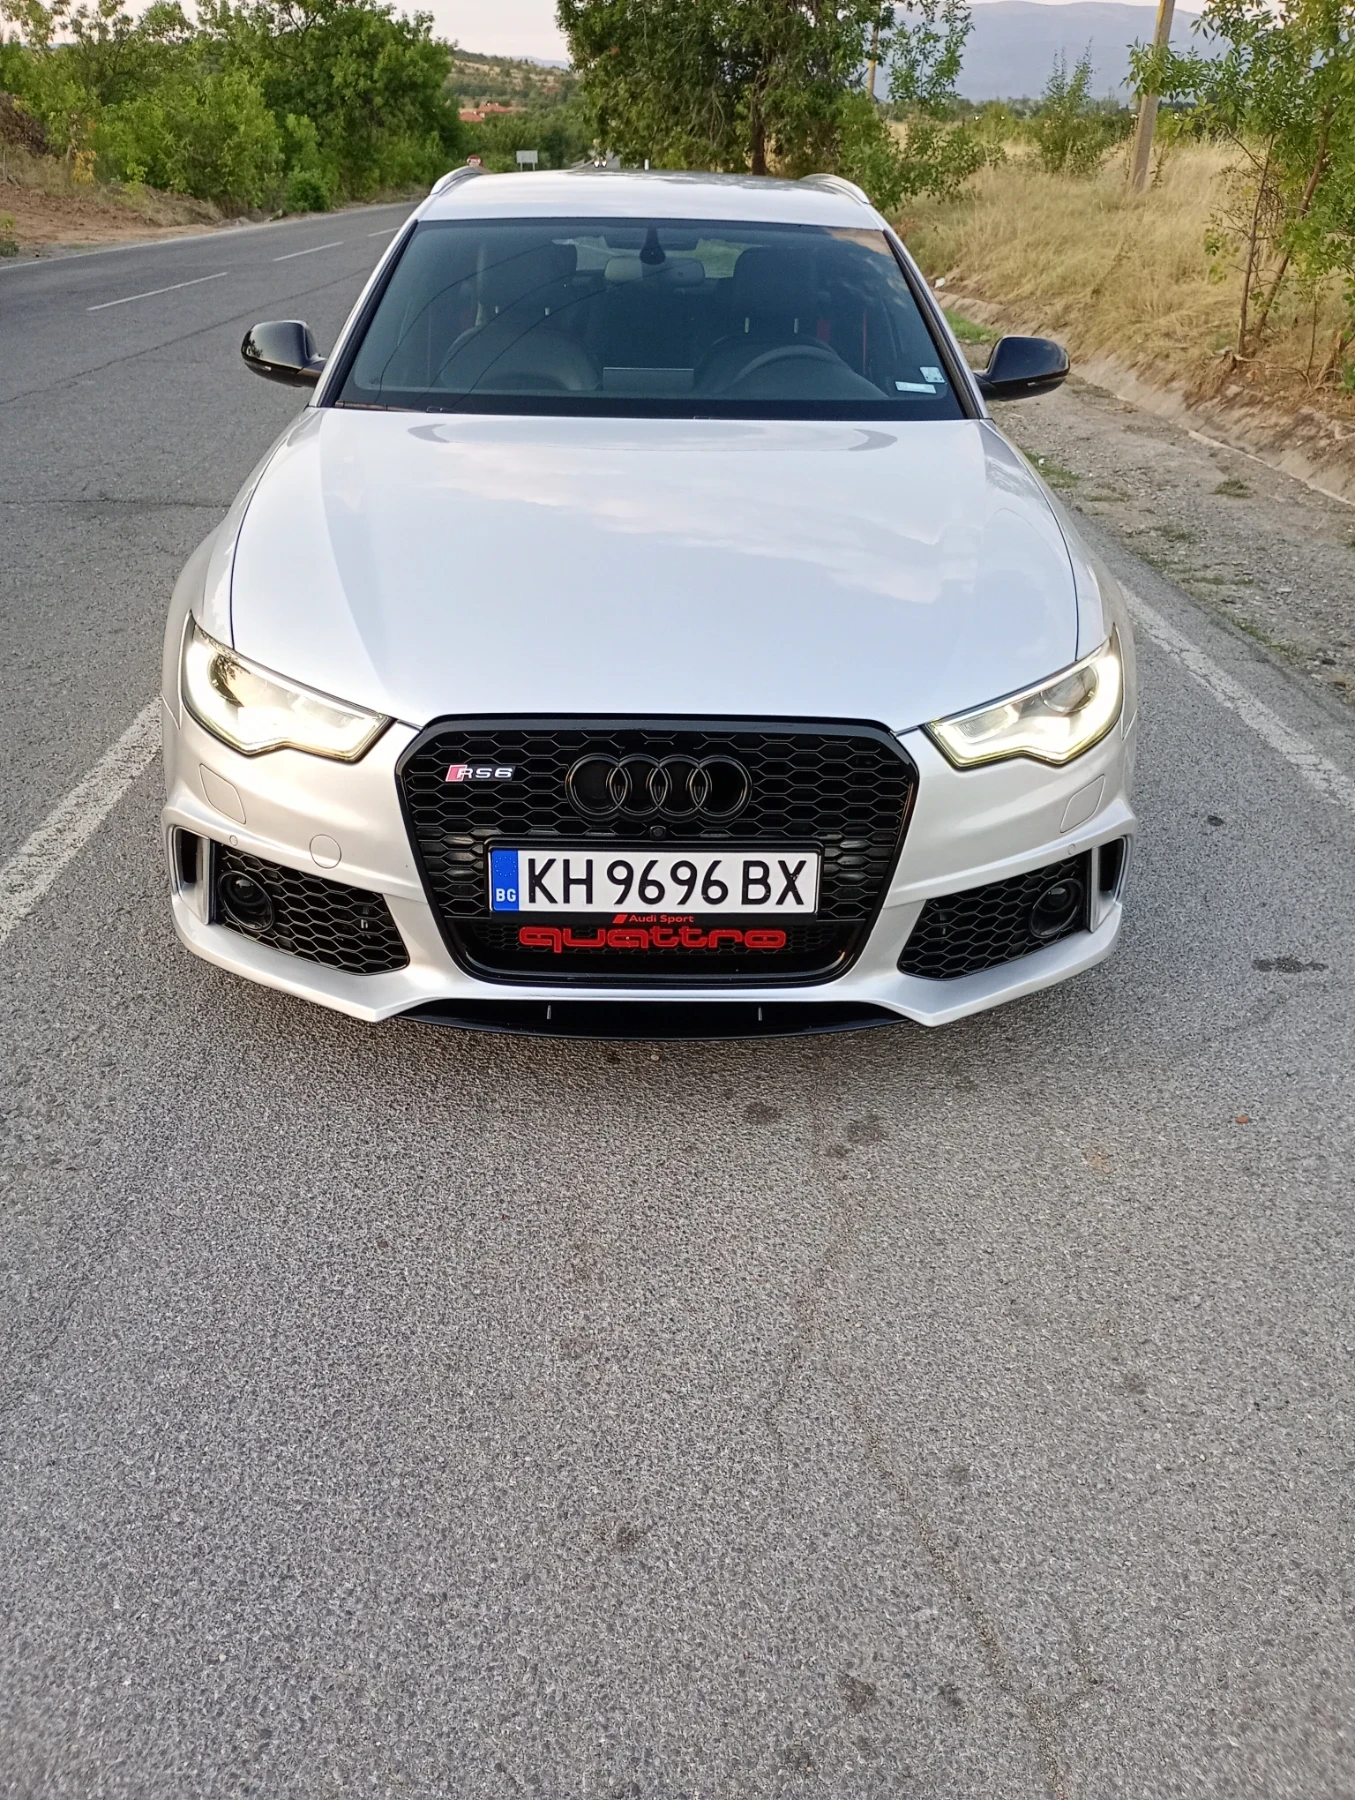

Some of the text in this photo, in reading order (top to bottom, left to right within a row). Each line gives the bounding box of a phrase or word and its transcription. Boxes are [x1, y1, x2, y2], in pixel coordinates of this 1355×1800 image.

[455, 767, 513, 779] RS6
[528, 858, 808, 906] KH 9696 BX
[495, 888, 517, 902] BG
[628, 914, 695, 924] Audi Sport
[519, 925, 787, 954] quattro
